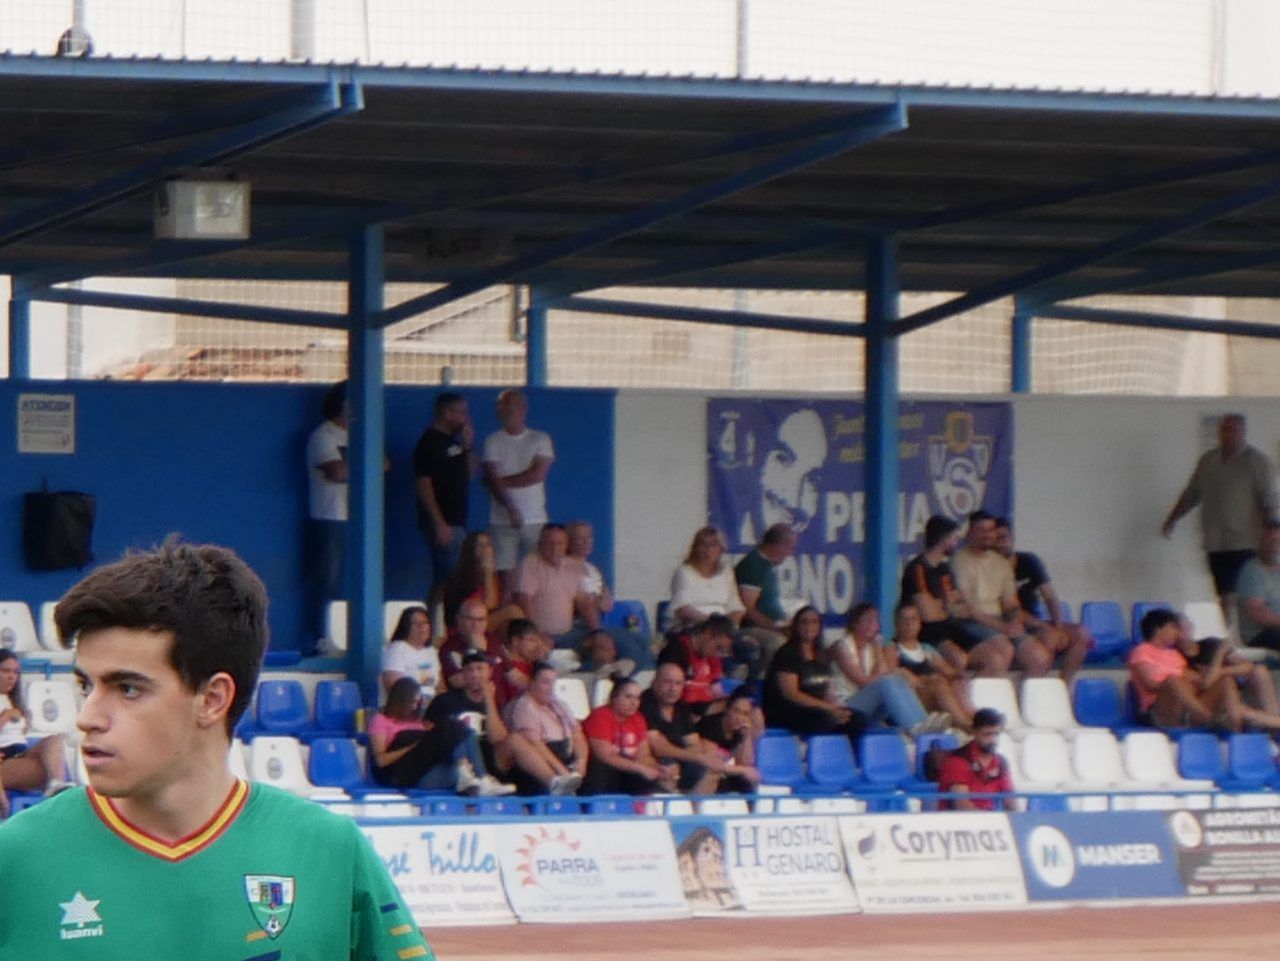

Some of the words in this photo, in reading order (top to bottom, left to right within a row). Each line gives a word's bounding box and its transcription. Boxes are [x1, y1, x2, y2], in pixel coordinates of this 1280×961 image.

[732, 826, 763, 868] H
[766, 824, 834, 847] HOSTAL
[889, 823, 1009, 861] Corymas
[420, 831, 497, 875] Trillo
[766, 851, 842, 876] GENARO
[1078, 843, 1162, 866] MANSER
[535, 857, 600, 876] PARRA
